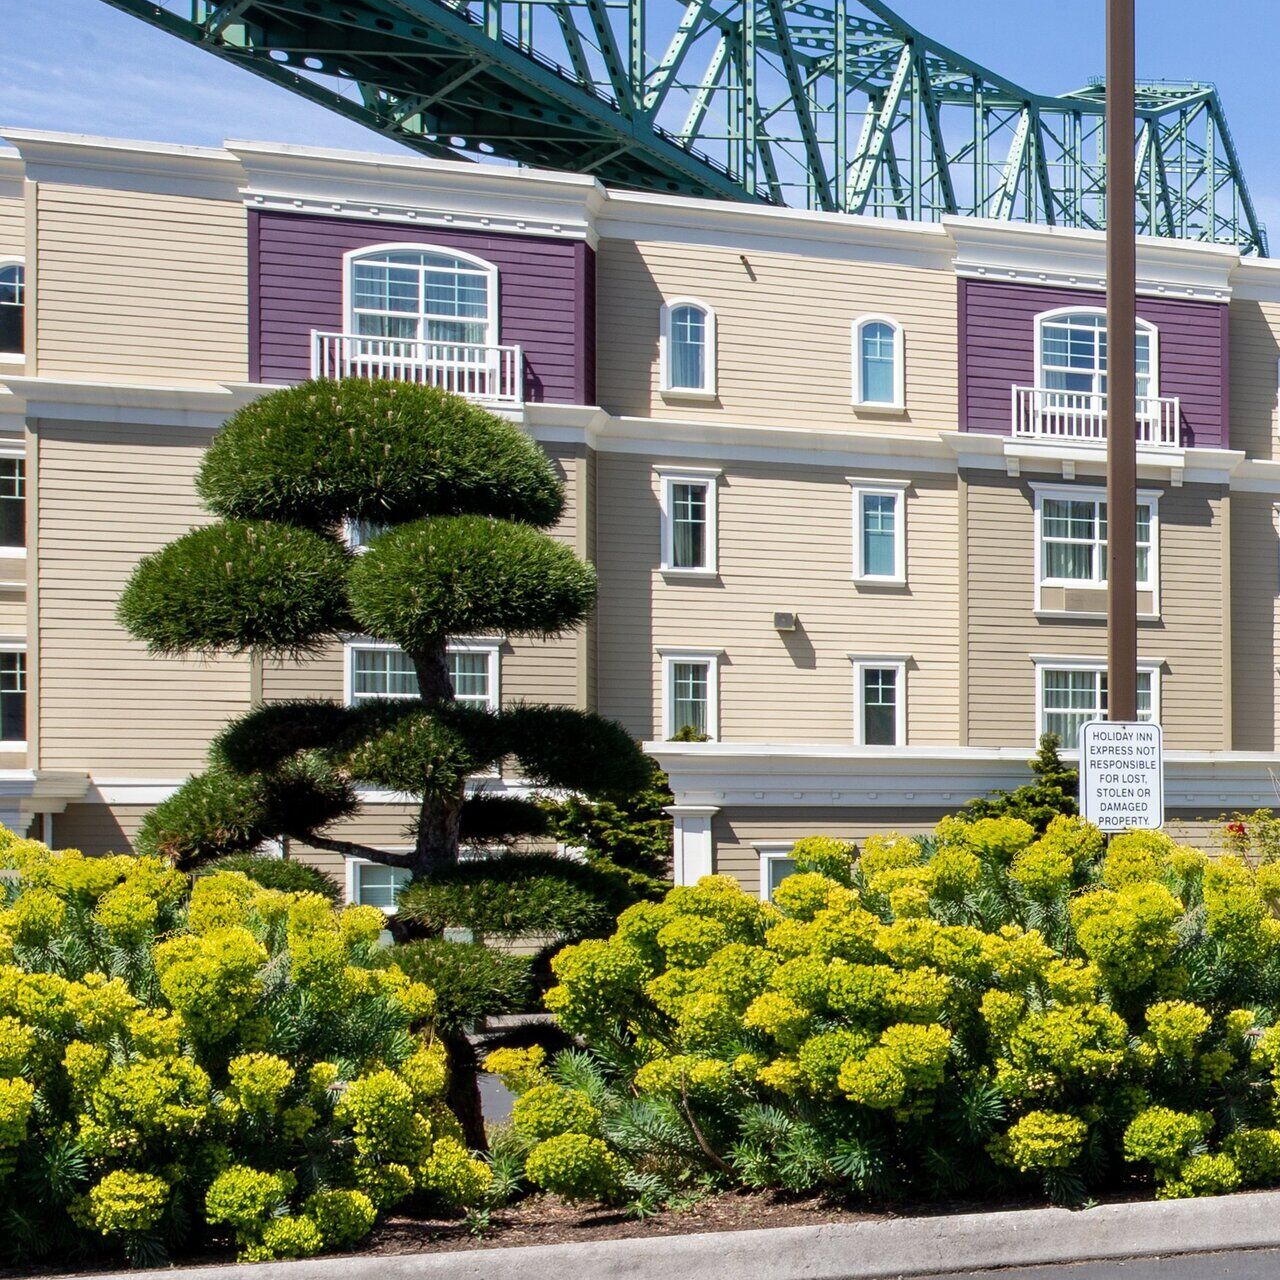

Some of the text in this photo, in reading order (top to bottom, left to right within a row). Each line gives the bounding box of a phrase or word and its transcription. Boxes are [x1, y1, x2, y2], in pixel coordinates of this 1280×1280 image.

[1092, 731, 1153, 741] HOLIDAY INN
[1090, 745, 1156, 755] EXPRESS NOT
[1090, 760, 1157, 770] RESPONSIBLE
[1099, 773, 1148, 784] FOR LOST,
[1096, 788, 1151, 798] STOLEN OR
[1100, 802, 1148, 812] DAMAGED
[1098, 816, 1150, 826] PROPERTY.
